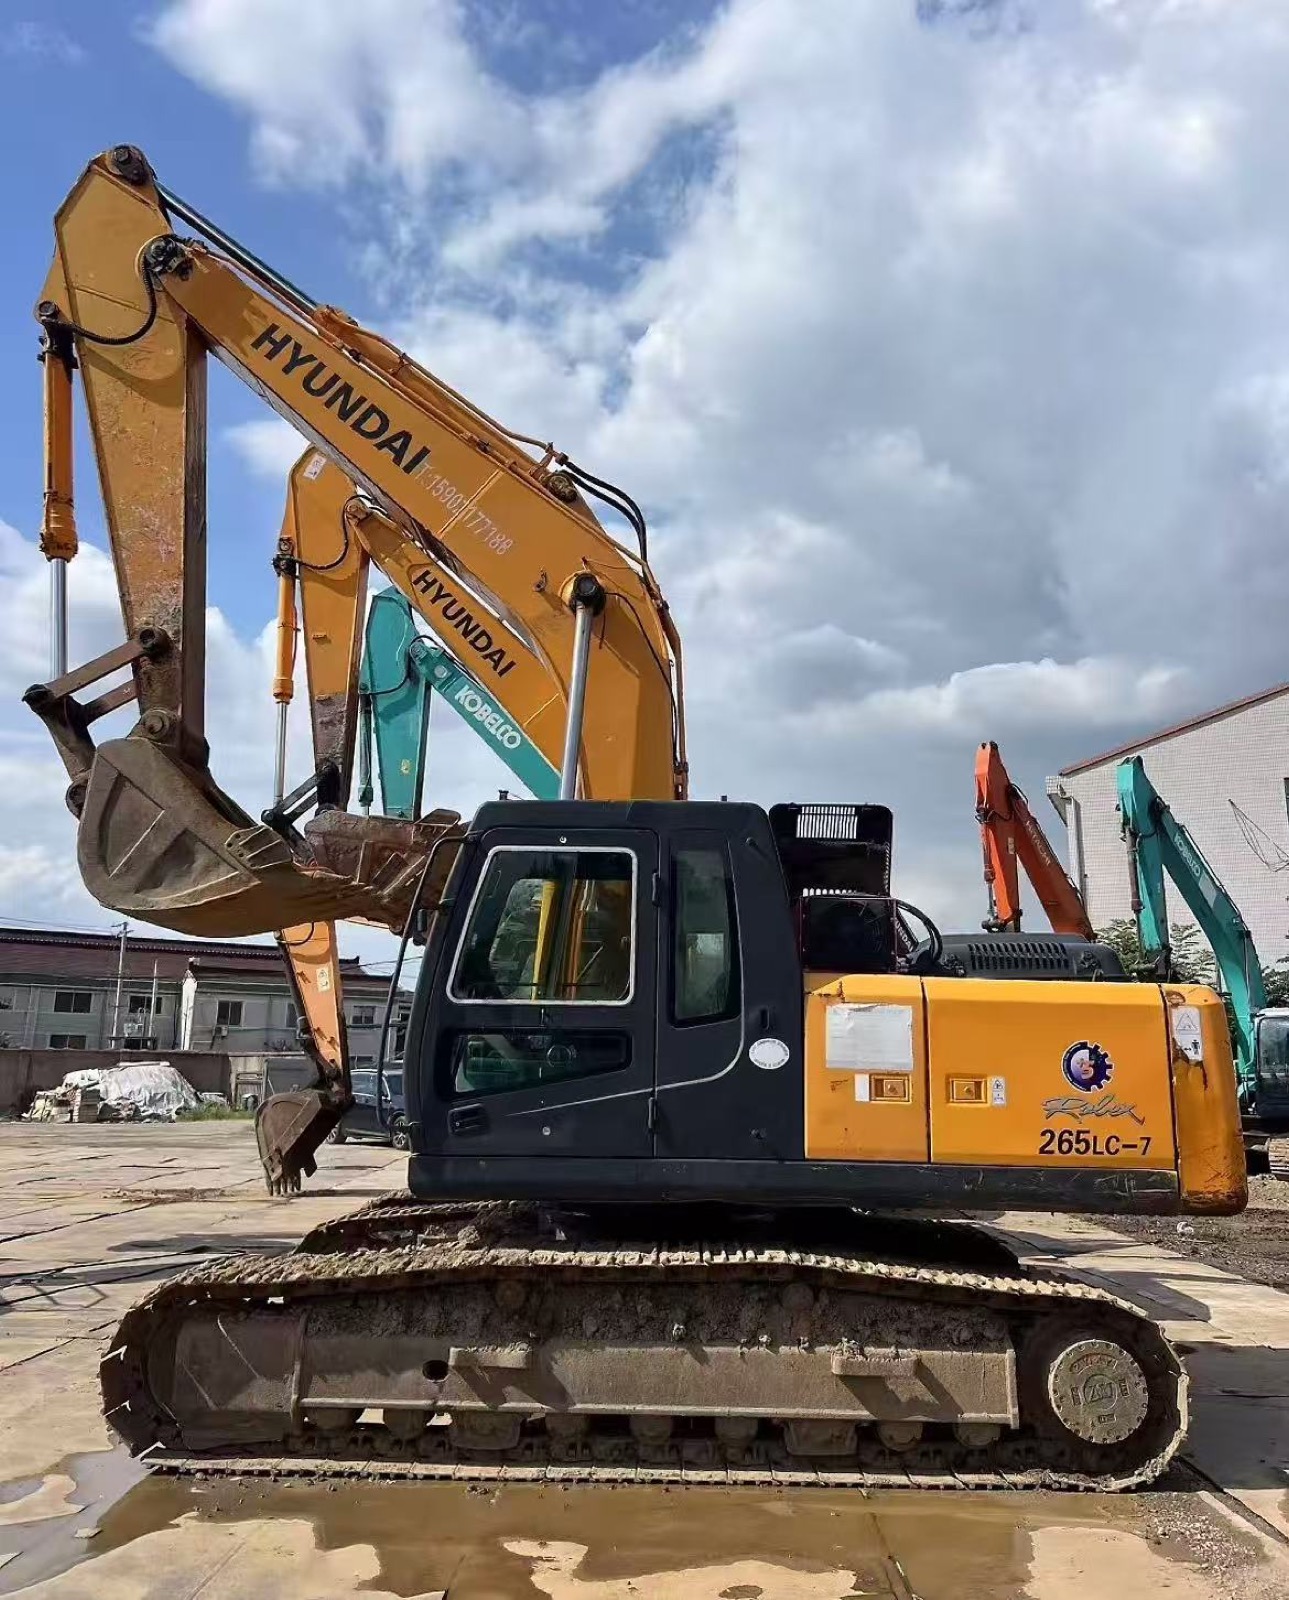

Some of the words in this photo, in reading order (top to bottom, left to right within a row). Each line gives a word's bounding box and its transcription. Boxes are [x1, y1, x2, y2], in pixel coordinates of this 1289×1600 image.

[251, 323, 431, 474] HYUNDAI
[413, 569, 516, 677] HYUNDAI
[454, 685, 521, 749] KOBELCO
[1038, 1129, 1152, 1156] 265LC-7
